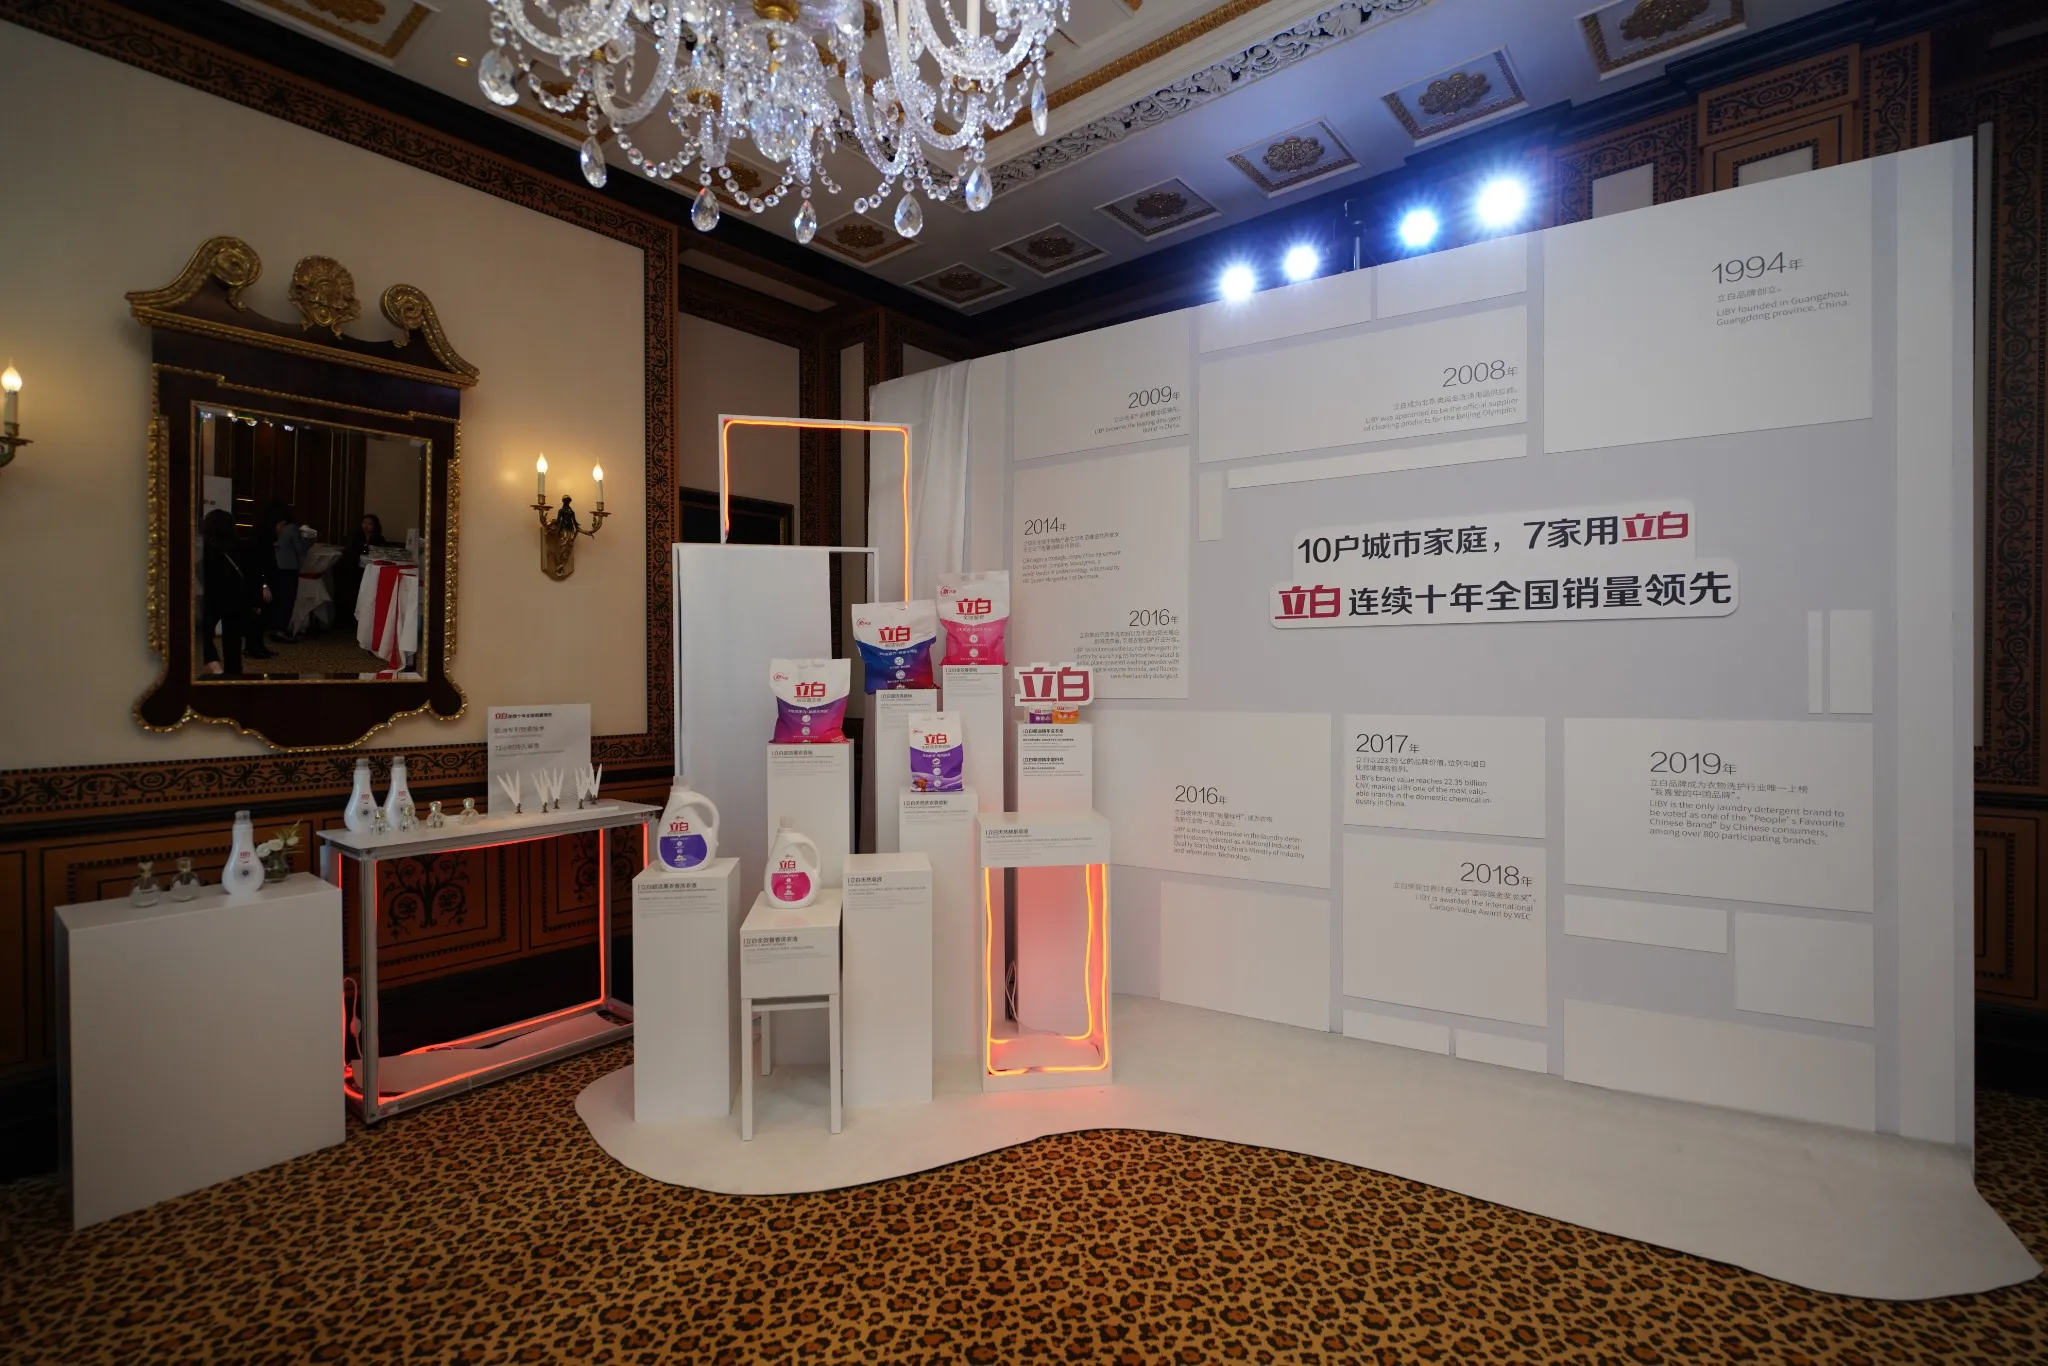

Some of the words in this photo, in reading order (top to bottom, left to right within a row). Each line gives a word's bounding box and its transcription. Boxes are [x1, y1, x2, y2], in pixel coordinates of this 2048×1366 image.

[1712, 252, 1803, 284] 1994年
[1716, 307, 1734, 316] LIBY
[1738, 301, 1776, 313] founded
[1780, 299, 1788, 307] in
[1791, 290, 1849, 307] Guangzhou,
[1716, 311, 1769, 327] Guangdong
[1773, 304, 1816, 318] province,
[1442, 360, 1518, 387] 2008年
[1129, 386, 1180, 409] 2009年
[1463, 401, 1487, 410] official
[1489, 397, 1518, 408] supplier
[1371, 421, 1399, 432] cleaning
[1401, 417, 1430, 428] products
[1456, 411, 1480, 421] Beijing
[1024, 517, 1066, 536] 2014年
[956, 598, 992, 615] 立白
[1130, 608, 1178, 626] 2016年
[878, 626, 910, 643] 立白
[794, 682, 825, 698] 立白
[1019, 667, 1090, 702] 立白
[924, 733, 947, 745] 立白
[1356, 734, 1419, 753] 2017年
[1650, 751, 1737, 775] 2019年
[1175, 785, 1228, 804] 2016年
[1650, 800, 1668, 808] LIBY
[1679, 801, 1693, 809] the
[1696, 802, 1714, 812] only
[1717, 803, 1752, 814] laundry
[1755, 805, 1799, 816] detergent
[1803, 808, 1831, 816] brand
[1834, 809, 1844, 817] to
[1650, 808, 1660, 816] be
[1663, 809, 1687, 817] voted
[1721, 812, 1730, 820] of
[1732, 813, 1746, 821] the
[1799, 817, 1845, 826] Favourite
[670, 822, 688, 832] 立白
[1215, 830, 1242, 838] enterprise
[1650, 817, 1683, 826] Chinese
[1720, 822, 1730, 831] by
[1733, 823, 1769, 832] Chinese
[1772, 827, 1828, 837] consumers,
[1649, 828, 1680, 837] among
[1704, 830, 1719, 838] 800
[1721, 832, 1780, 844] participating
[1783, 836, 1819, 845] brands.
[779, 860, 796, 869] 立白
[1461, 862, 1532, 886] 2018年
[1439, 896, 1470, 905] awarded
[1486, 901, 1532, 911] International
[1503, 911, 1512, 919] by
